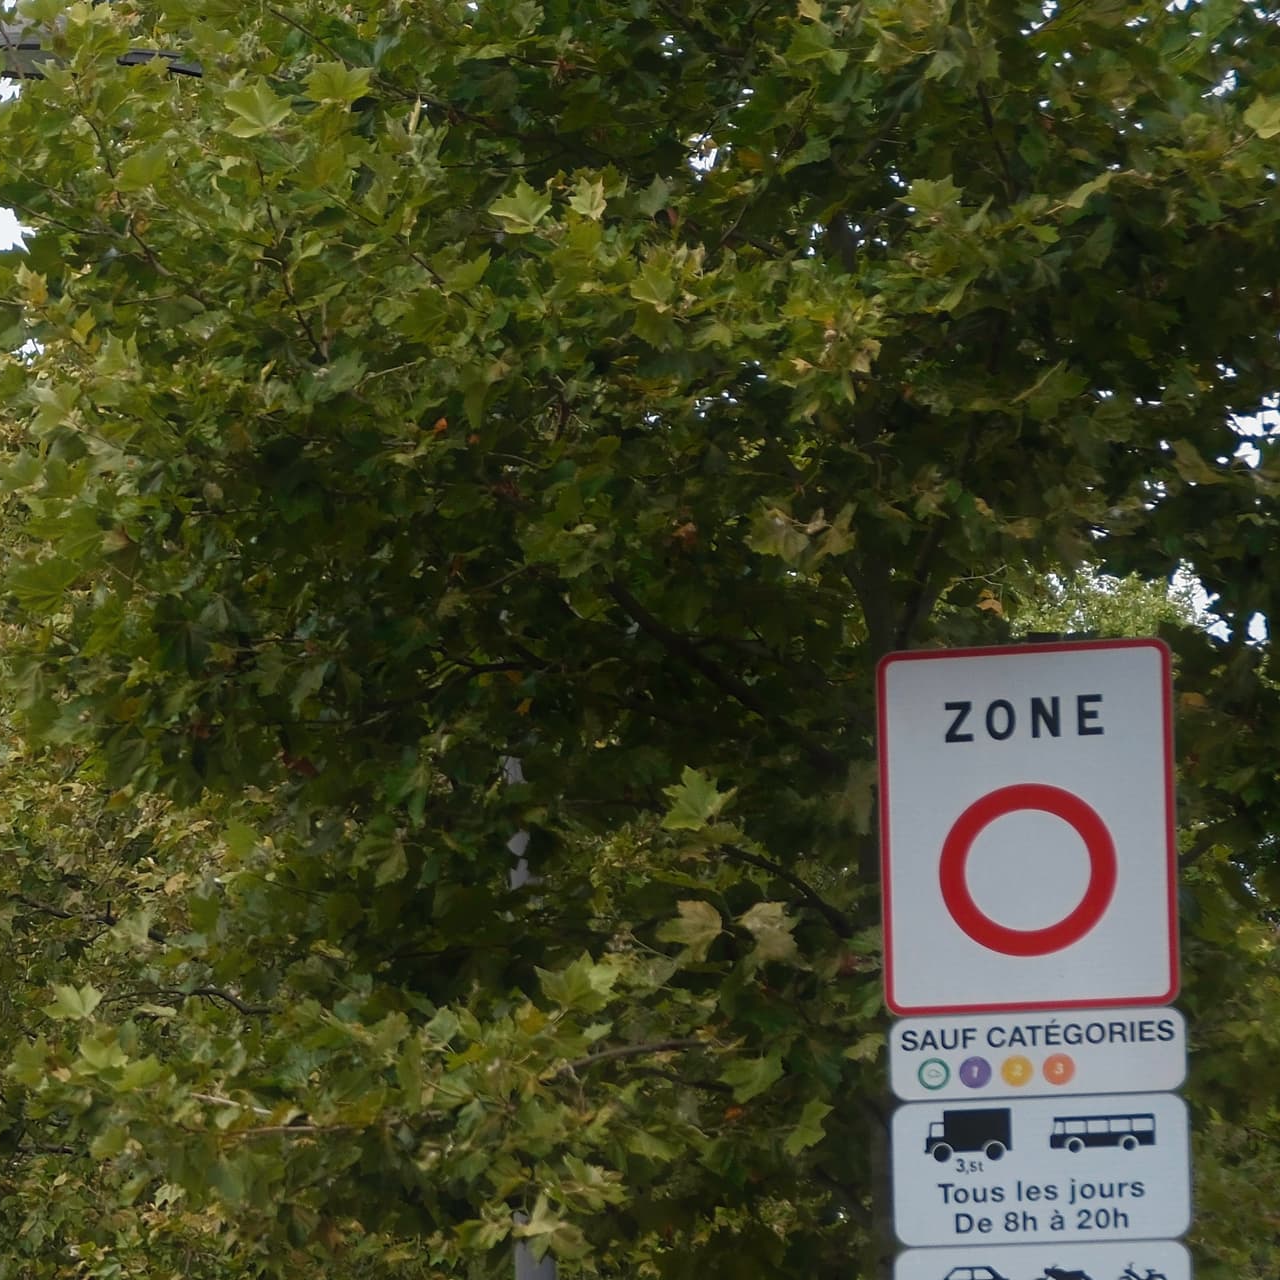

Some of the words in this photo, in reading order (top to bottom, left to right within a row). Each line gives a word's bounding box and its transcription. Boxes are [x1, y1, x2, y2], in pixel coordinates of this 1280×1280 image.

[944, 694, 1105, 743] ZONE
[901, 1027, 977, 1052] SAUF
[987, 1018, 1175, 1048] CATÉGORIES
[938, 1182, 1005, 1204] Tous
[1017, 1181, 1059, 1202] les
[1068, 1179, 1145, 1205] jours
[955, 1213, 993, 1234] De
[1004, 1210, 1038, 1232] 8h
[1050, 1209, 1065, 1231] à
[1077, 1208, 1130, 1230] 20h
